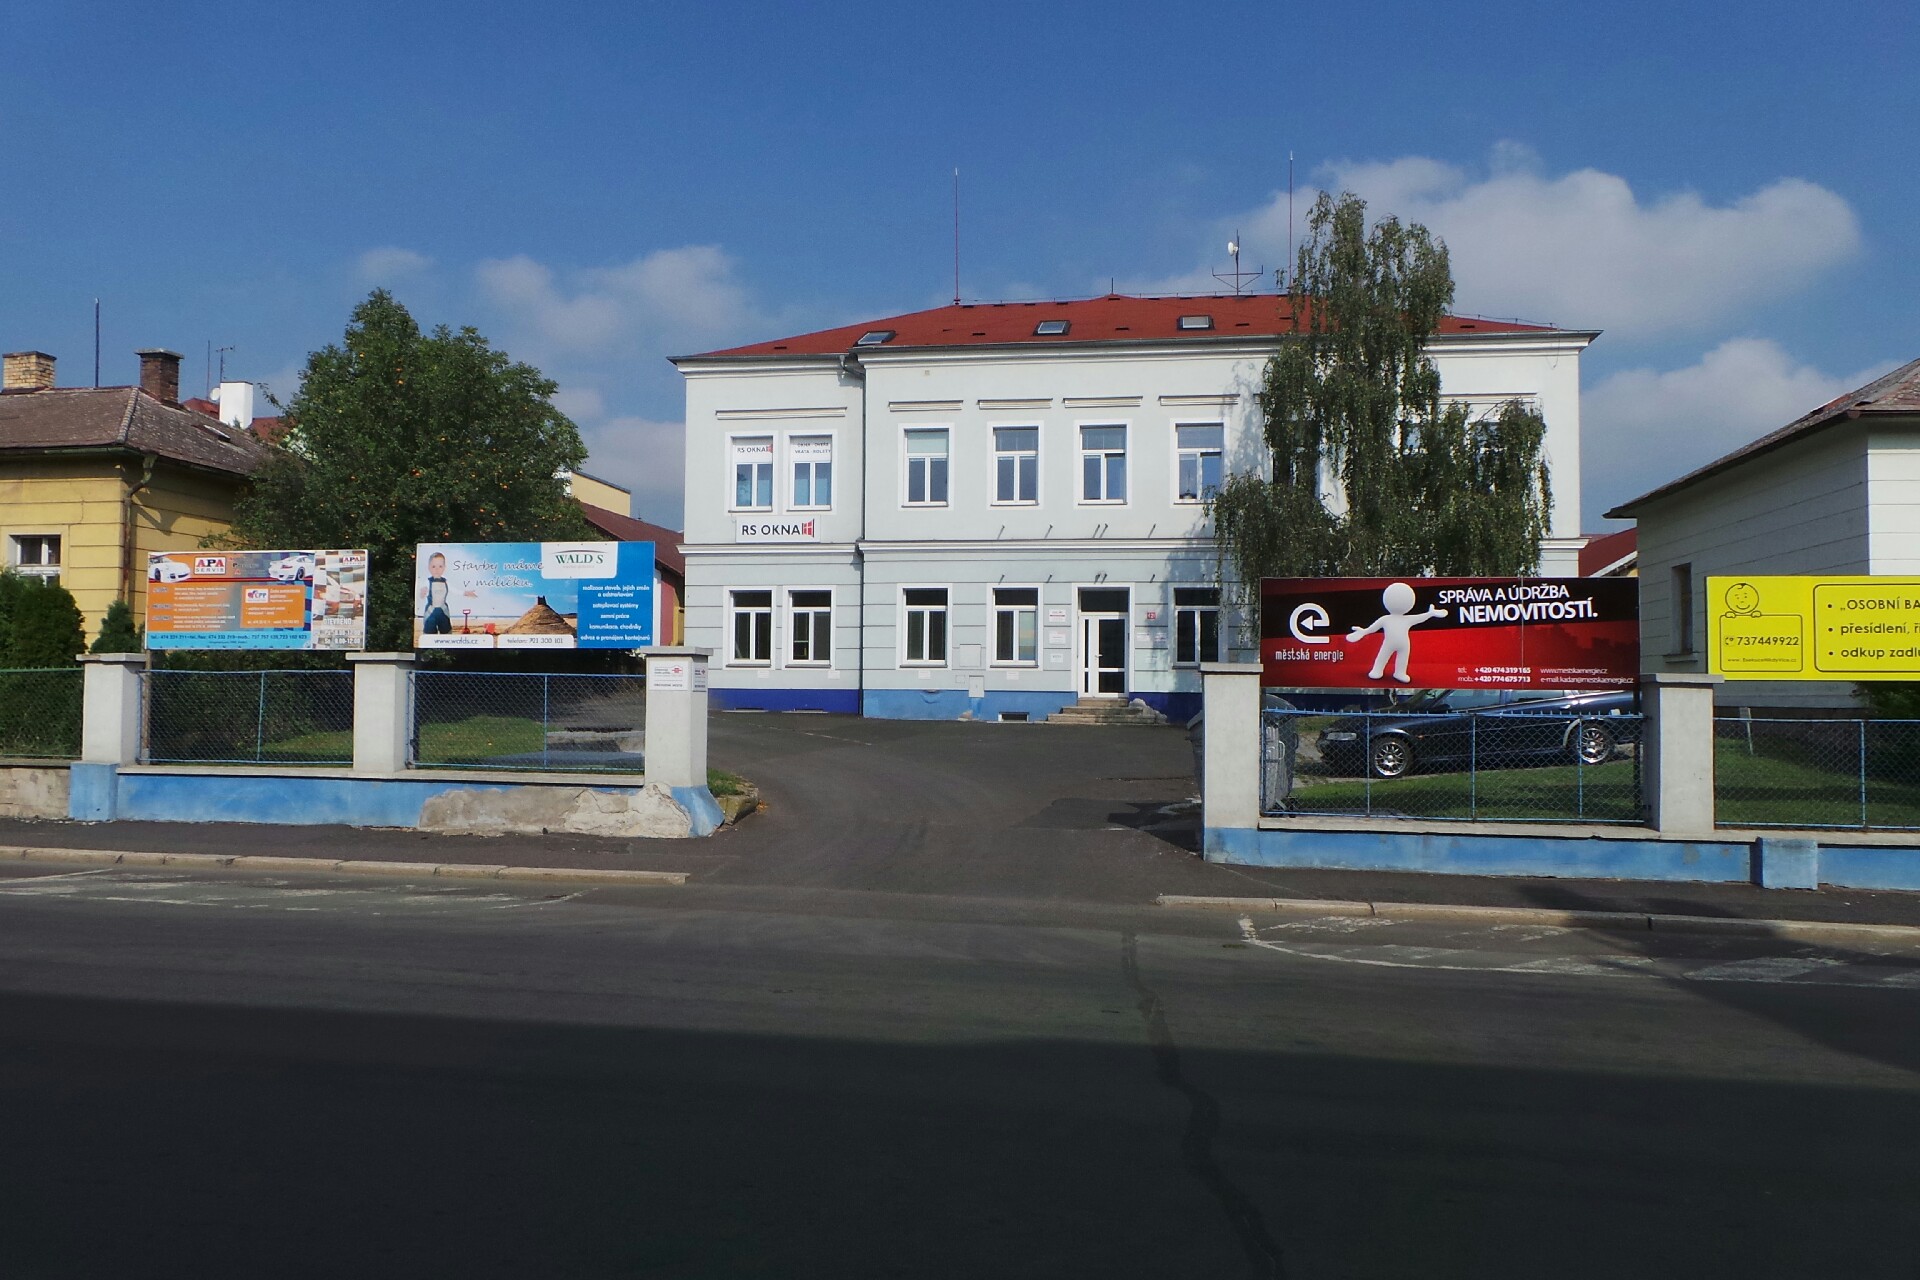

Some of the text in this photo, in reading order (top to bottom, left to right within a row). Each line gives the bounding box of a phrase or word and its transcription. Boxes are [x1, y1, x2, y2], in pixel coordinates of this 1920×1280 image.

[742, 524, 800, 535] RS OKNA
[196, 558, 224, 568] APA
[555, 554, 604, 564] WALD S
[453, 560, 544, 574] Stavby máme
[1439, 583, 1570, 604] SPRÁVA A ÚDRŽBA
[1459, 596, 1598, 624] NEMOVITOSTÍ.
[1841, 622, 1910, 636] přesídlení,
[1737, 636, 1799, 646] 737449922
[1275, 648, 1344, 663] městská energie
[1841, 647, 1920, 660] odkup zadl
